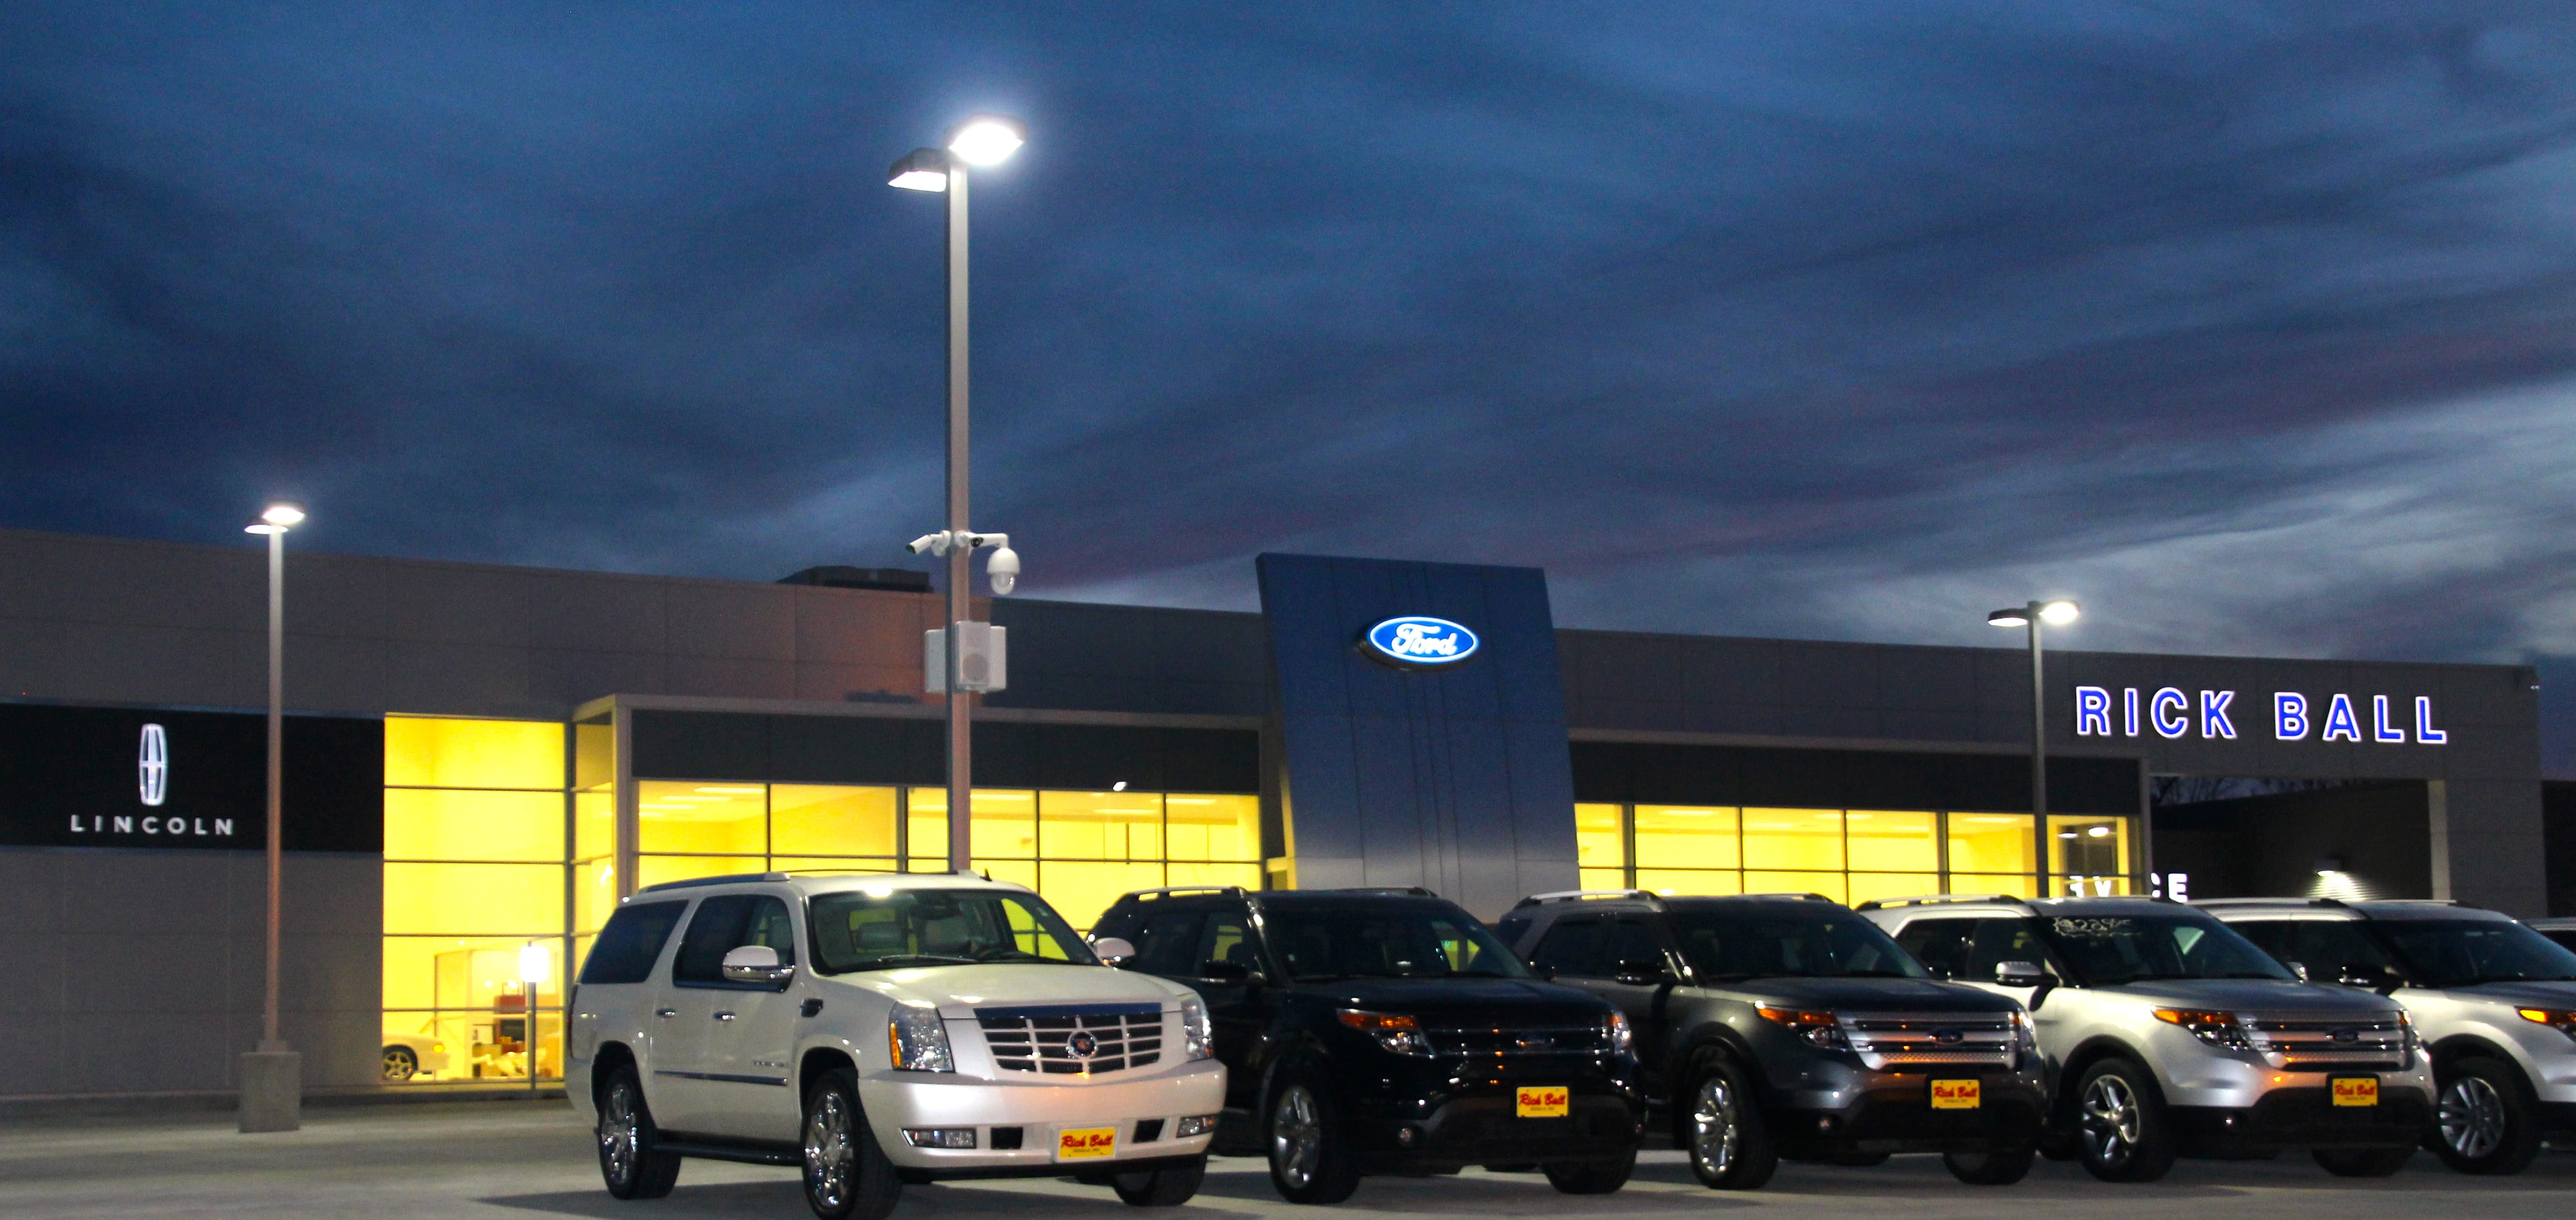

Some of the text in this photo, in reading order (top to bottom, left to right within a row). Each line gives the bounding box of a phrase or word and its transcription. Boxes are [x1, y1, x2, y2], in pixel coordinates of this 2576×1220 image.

[1391, 623, 1457, 655] Ford
[2076, 686, 2447, 744] RICK BALL
[71, 814, 233, 835] LINCOLN
[1060, 1134, 1114, 1147] Rick Ball
